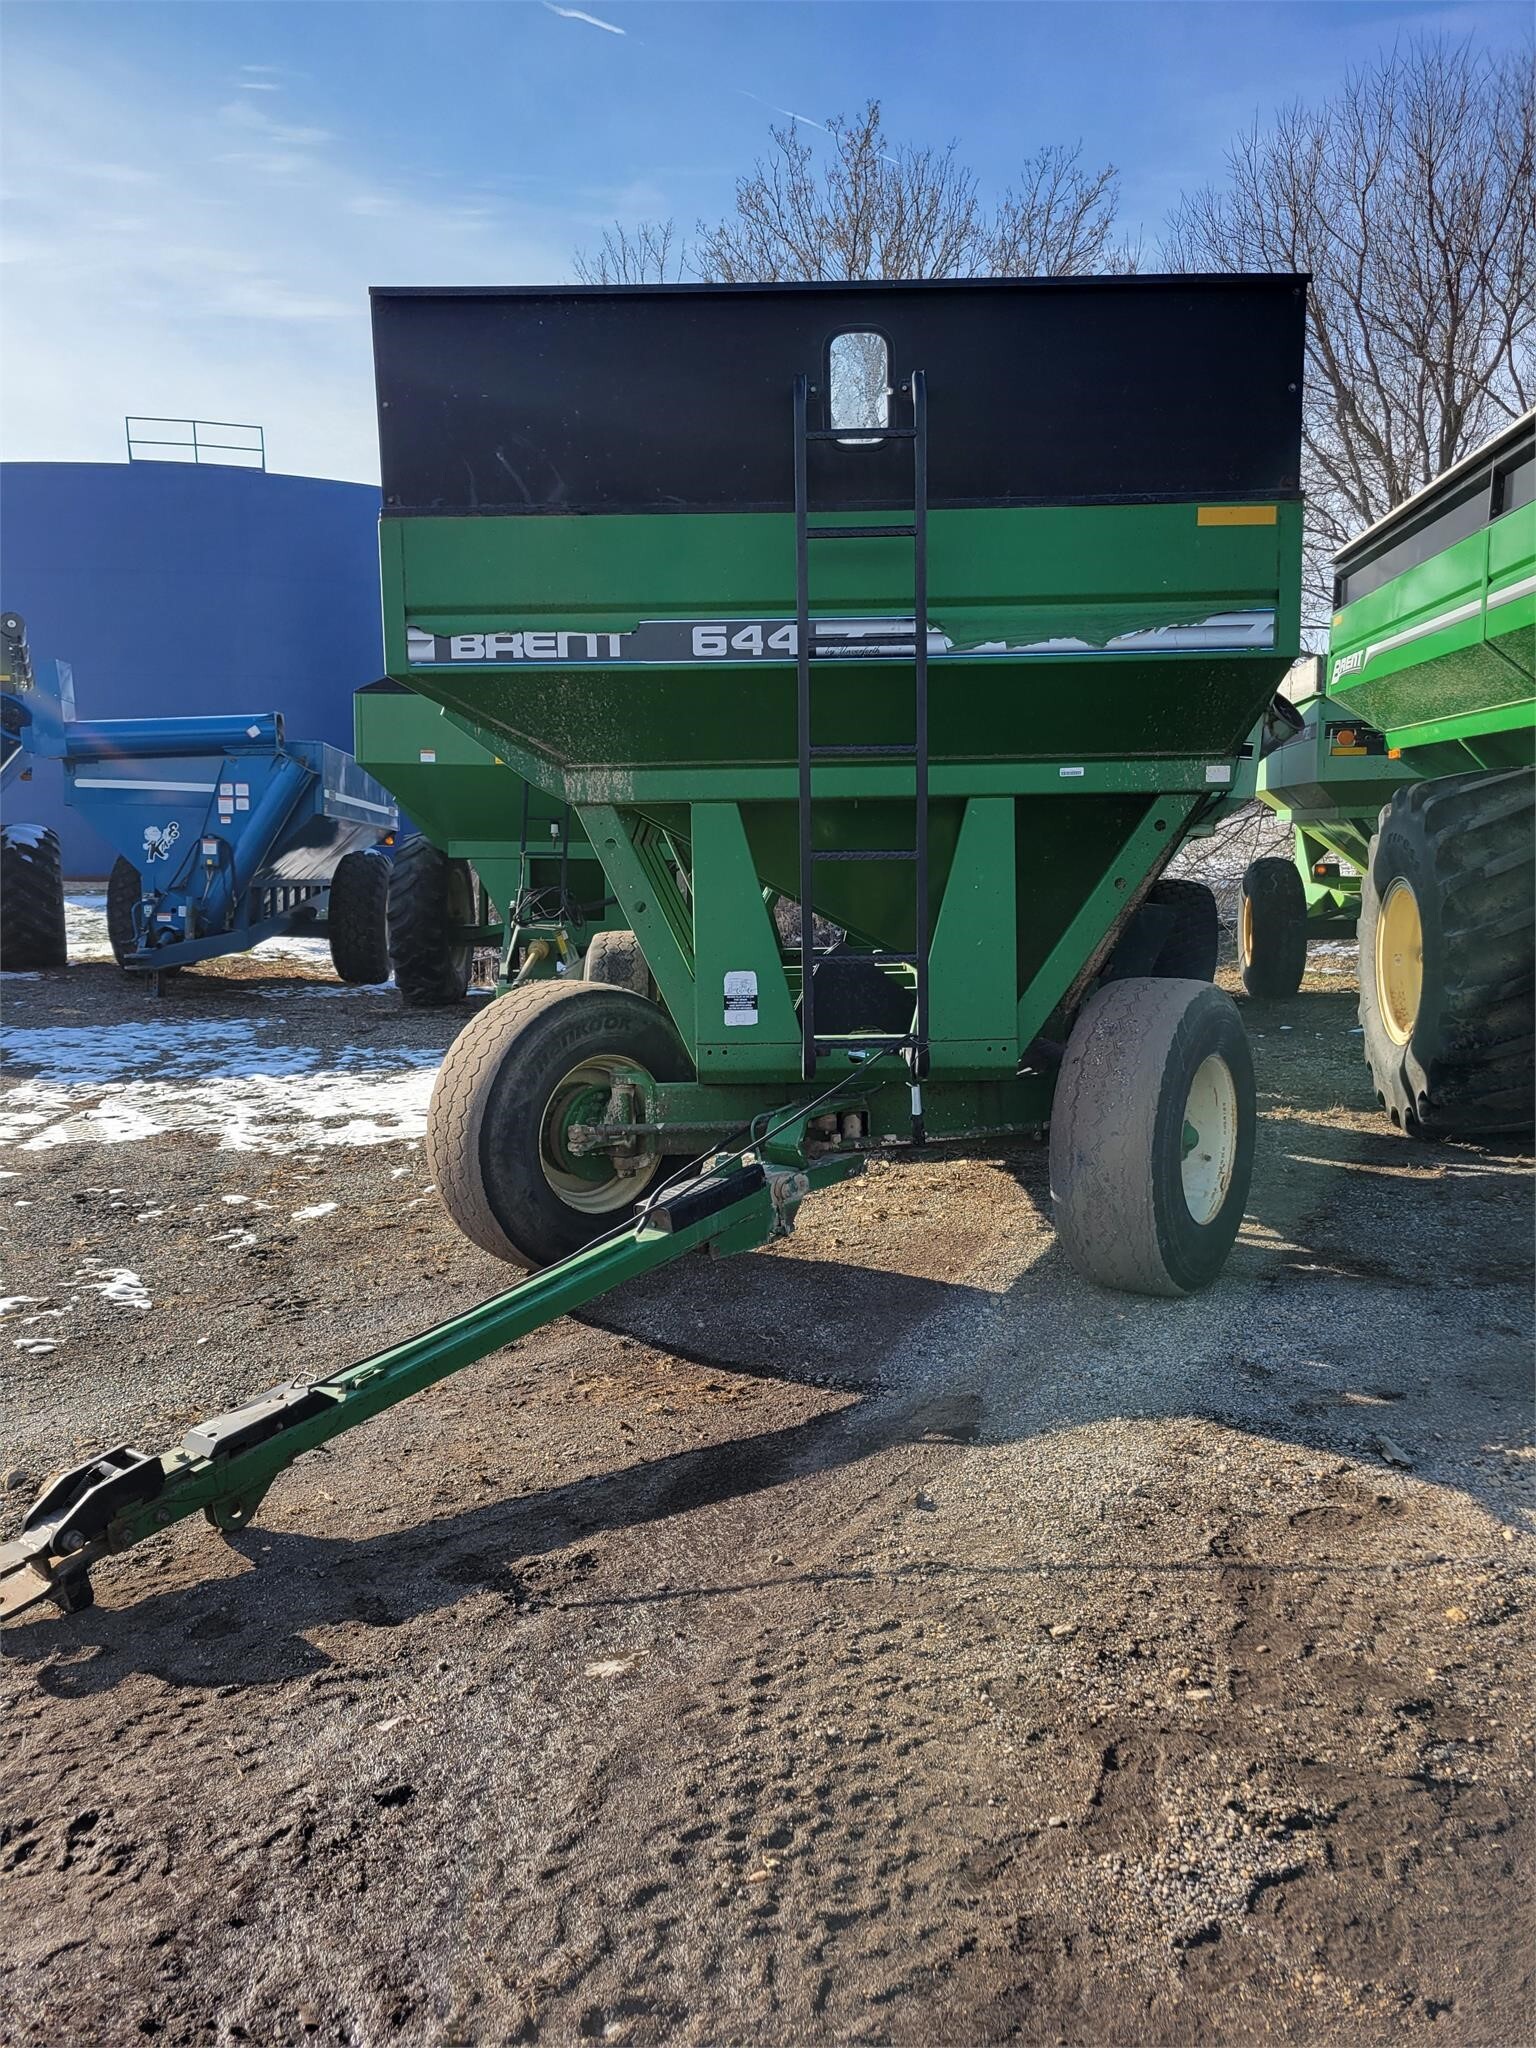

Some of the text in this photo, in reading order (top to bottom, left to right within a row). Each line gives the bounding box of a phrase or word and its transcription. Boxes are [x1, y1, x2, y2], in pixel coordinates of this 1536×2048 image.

[451, 625, 799, 660] BRENT 644
[1331, 649, 1364, 685] BRENT
